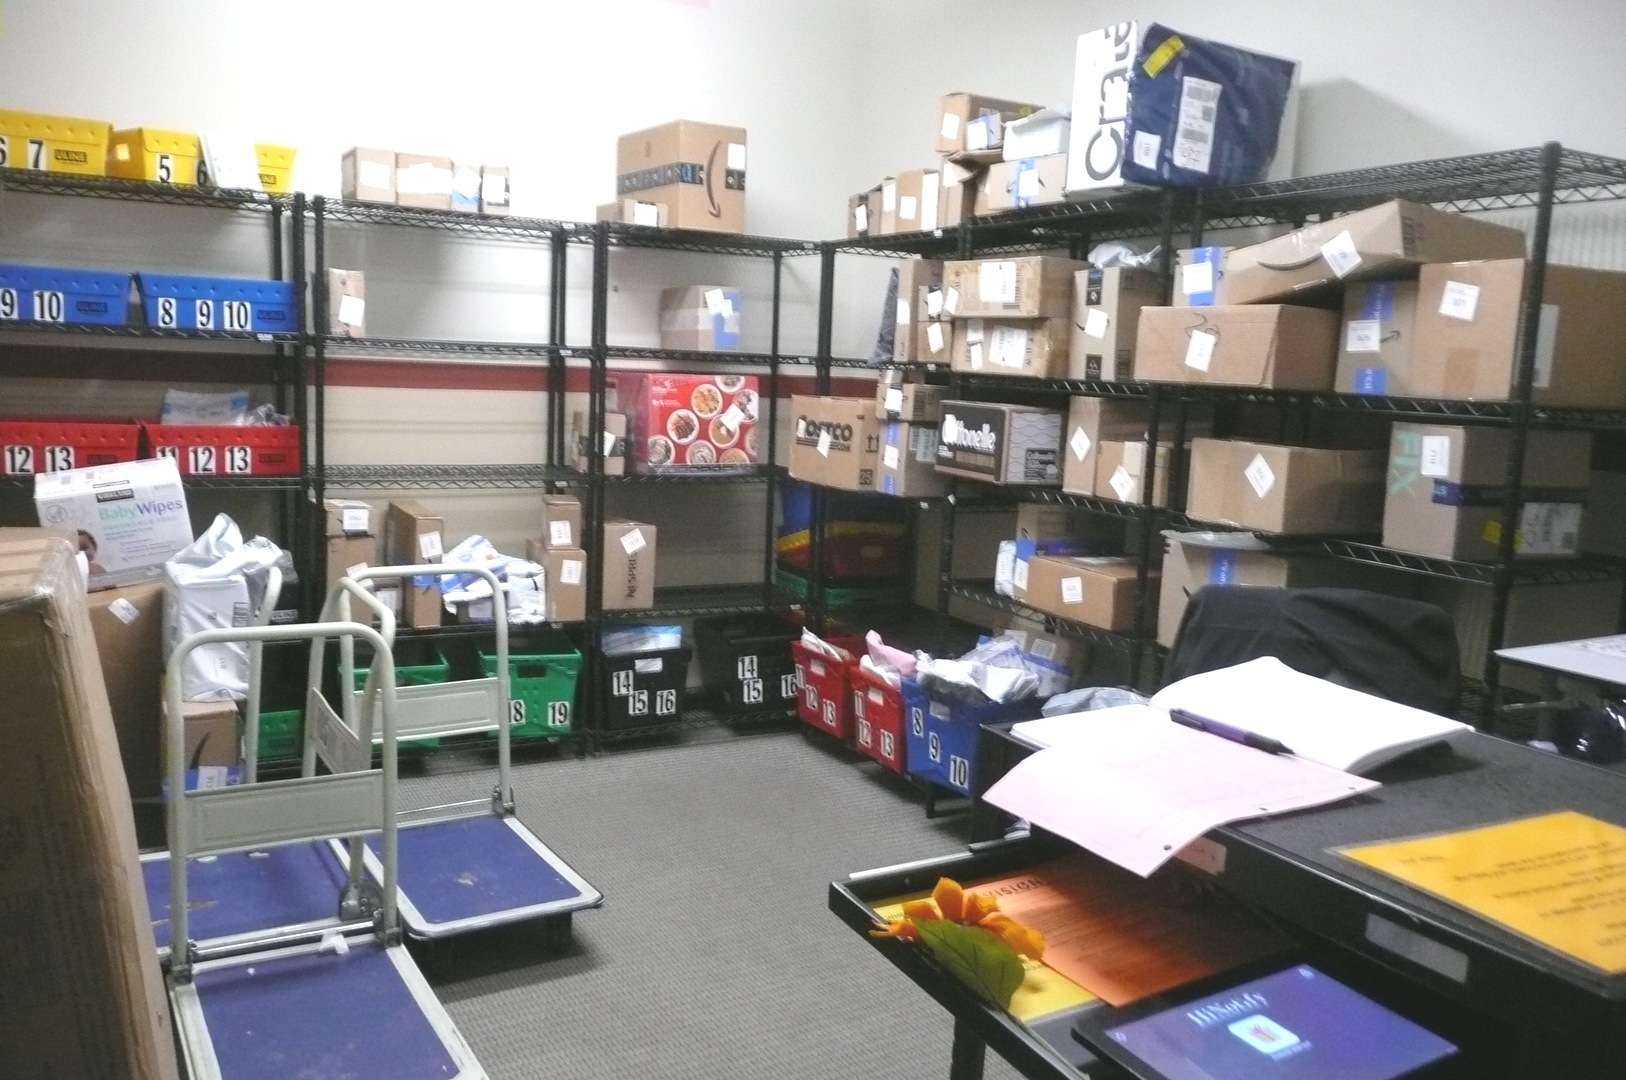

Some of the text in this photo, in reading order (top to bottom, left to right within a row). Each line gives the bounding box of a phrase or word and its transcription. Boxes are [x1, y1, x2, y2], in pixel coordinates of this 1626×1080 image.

[29, 139, 43, 169] 7
[159, 155, 207, 185] 5 6
[1, 288, 61, 321] 9 10
[161, 299, 249, 329] 8 9 10
[7, 446, 31, 473] 12
[48, 446, 72, 472] 13
[191, 447, 214, 473] 12
[227, 447, 249, 472] 13
[99, 500, 183, 520] Baby Wipes
[740, 657, 757, 678] 14
[614, 673, 631, 694] 14
[745, 680, 761, 701] 15
[783, 675, 797, 697] 16
[549, 703, 568, 724] 19
[631, 691, 674, 714] 15 16
[856, 691, 865, 717] 11
[861, 720, 871, 746] 12
[912, 708, 922, 735] 8
[883, 733, 894, 758] 13
[930, 734, 940, 760] 9
[951, 758, 967, 786] 10
